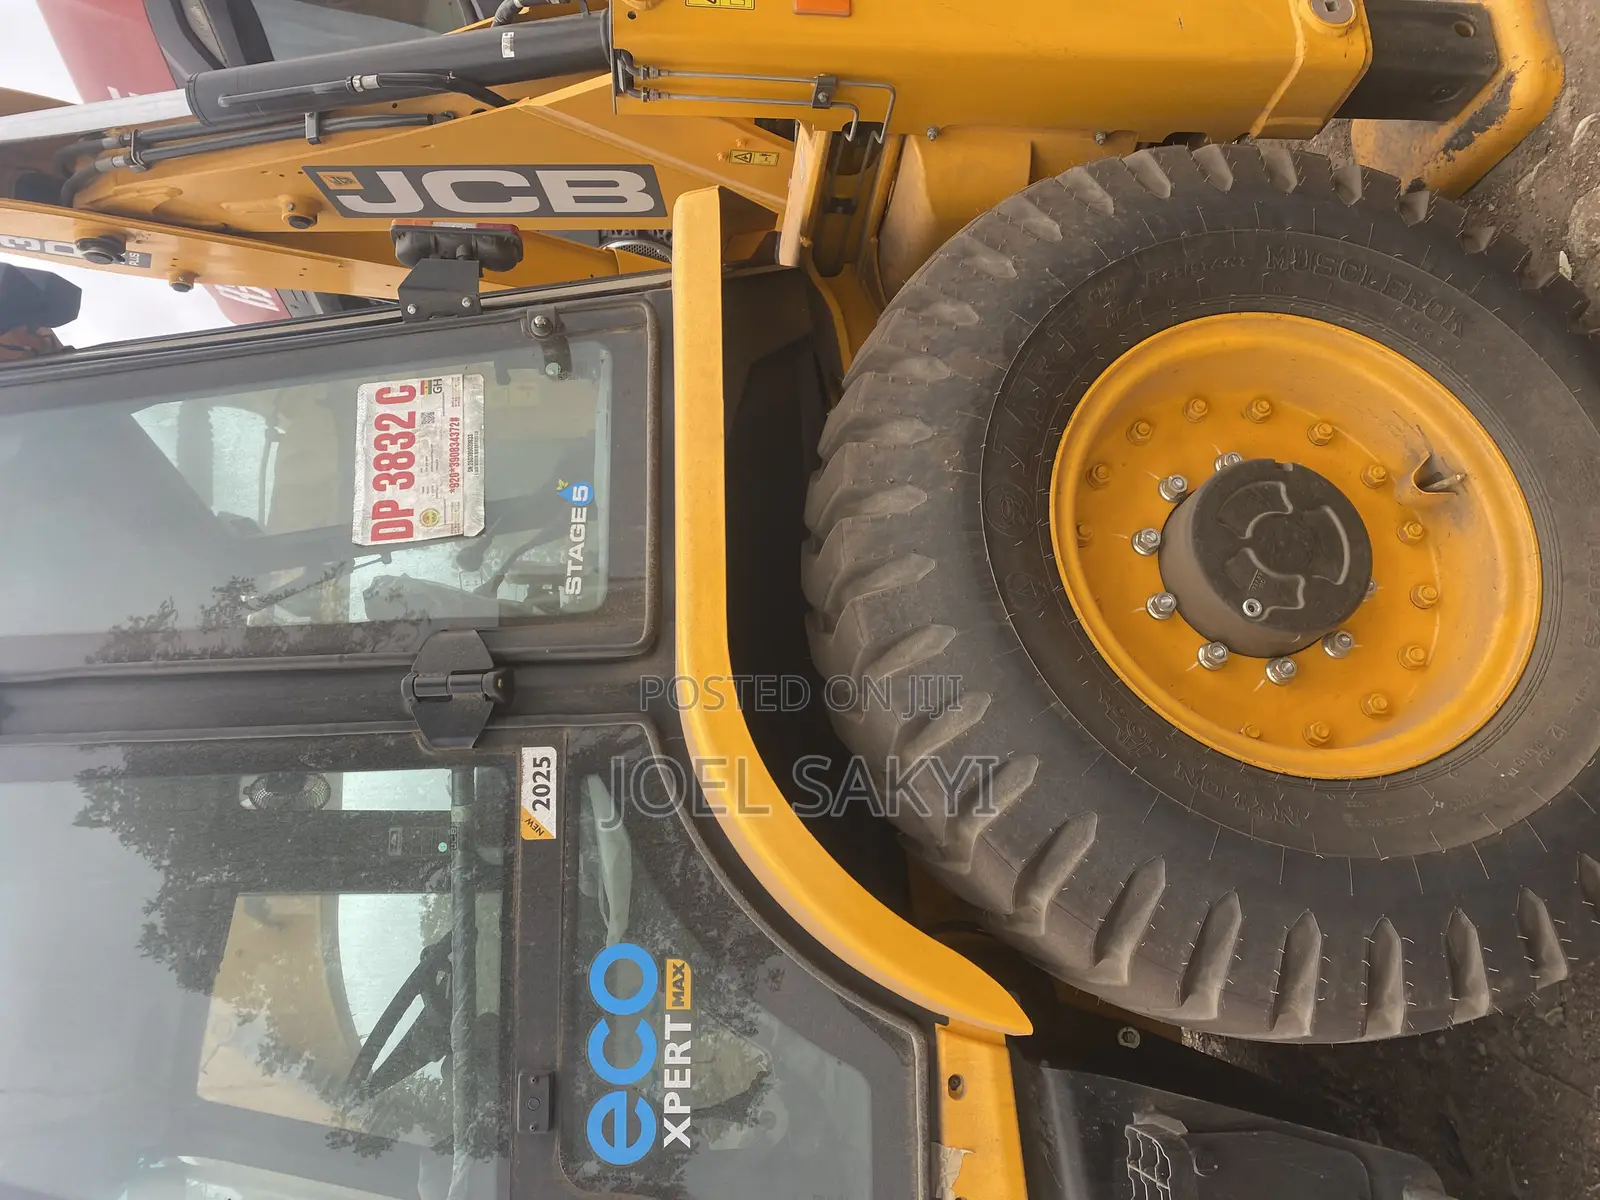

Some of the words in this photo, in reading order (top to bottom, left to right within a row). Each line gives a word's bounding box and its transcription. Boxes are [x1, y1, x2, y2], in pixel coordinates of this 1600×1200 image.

[336, 170, 656, 214] JCB
[129, 252, 140, 266] PLUS
[1264, 243, 1465, 338] MUSCLEROK
[375, 385, 417, 405] C
[433, 378, 443, 394] GH
[372, 411, 416, 492] 3832
[572, 485, 589, 502] 5
[370, 499, 414, 542] DP
[564, 507, 587, 595] STAGE
[531, 756, 551, 812] 2025
[1173, 761, 1310, 828] NYLON
[524, 817, 545, 837] NEW
[669, 962, 690, 1009] MAX
[587, 943, 659, 1166] eco
[662, 1014, 692, 1148] XPERT
